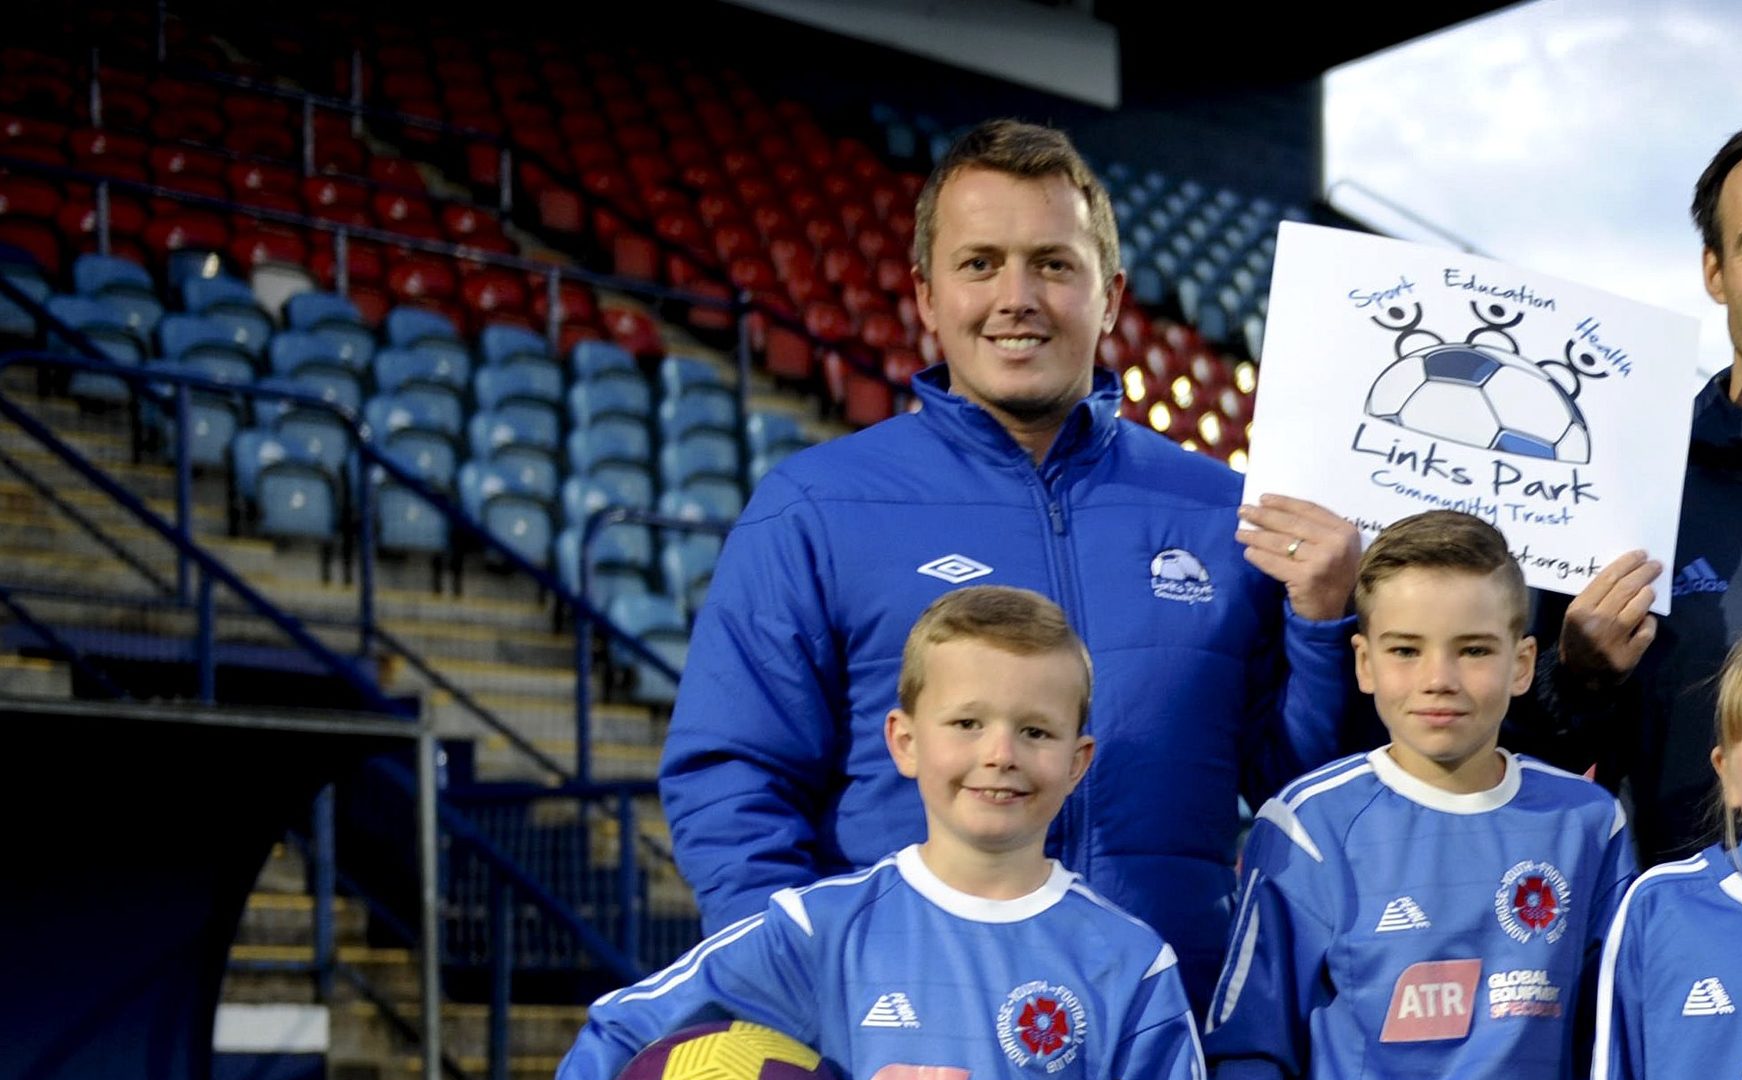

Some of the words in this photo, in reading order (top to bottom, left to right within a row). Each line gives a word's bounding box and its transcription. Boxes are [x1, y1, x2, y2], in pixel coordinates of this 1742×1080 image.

[1348, 275, 1416, 308] Sport
[1443, 268, 1556, 311] Education
[1575, 316, 1632, 377] Health
[1351, 422, 1473, 485] Links
[1492, 459, 1600, 504] Park
[1371, 470, 1498, 527] Community
[1503, 503, 1574, 525] Trust
[1398, 982, 1465, 1019] ATR
[1488, 970, 1551, 988] GLOBAL
